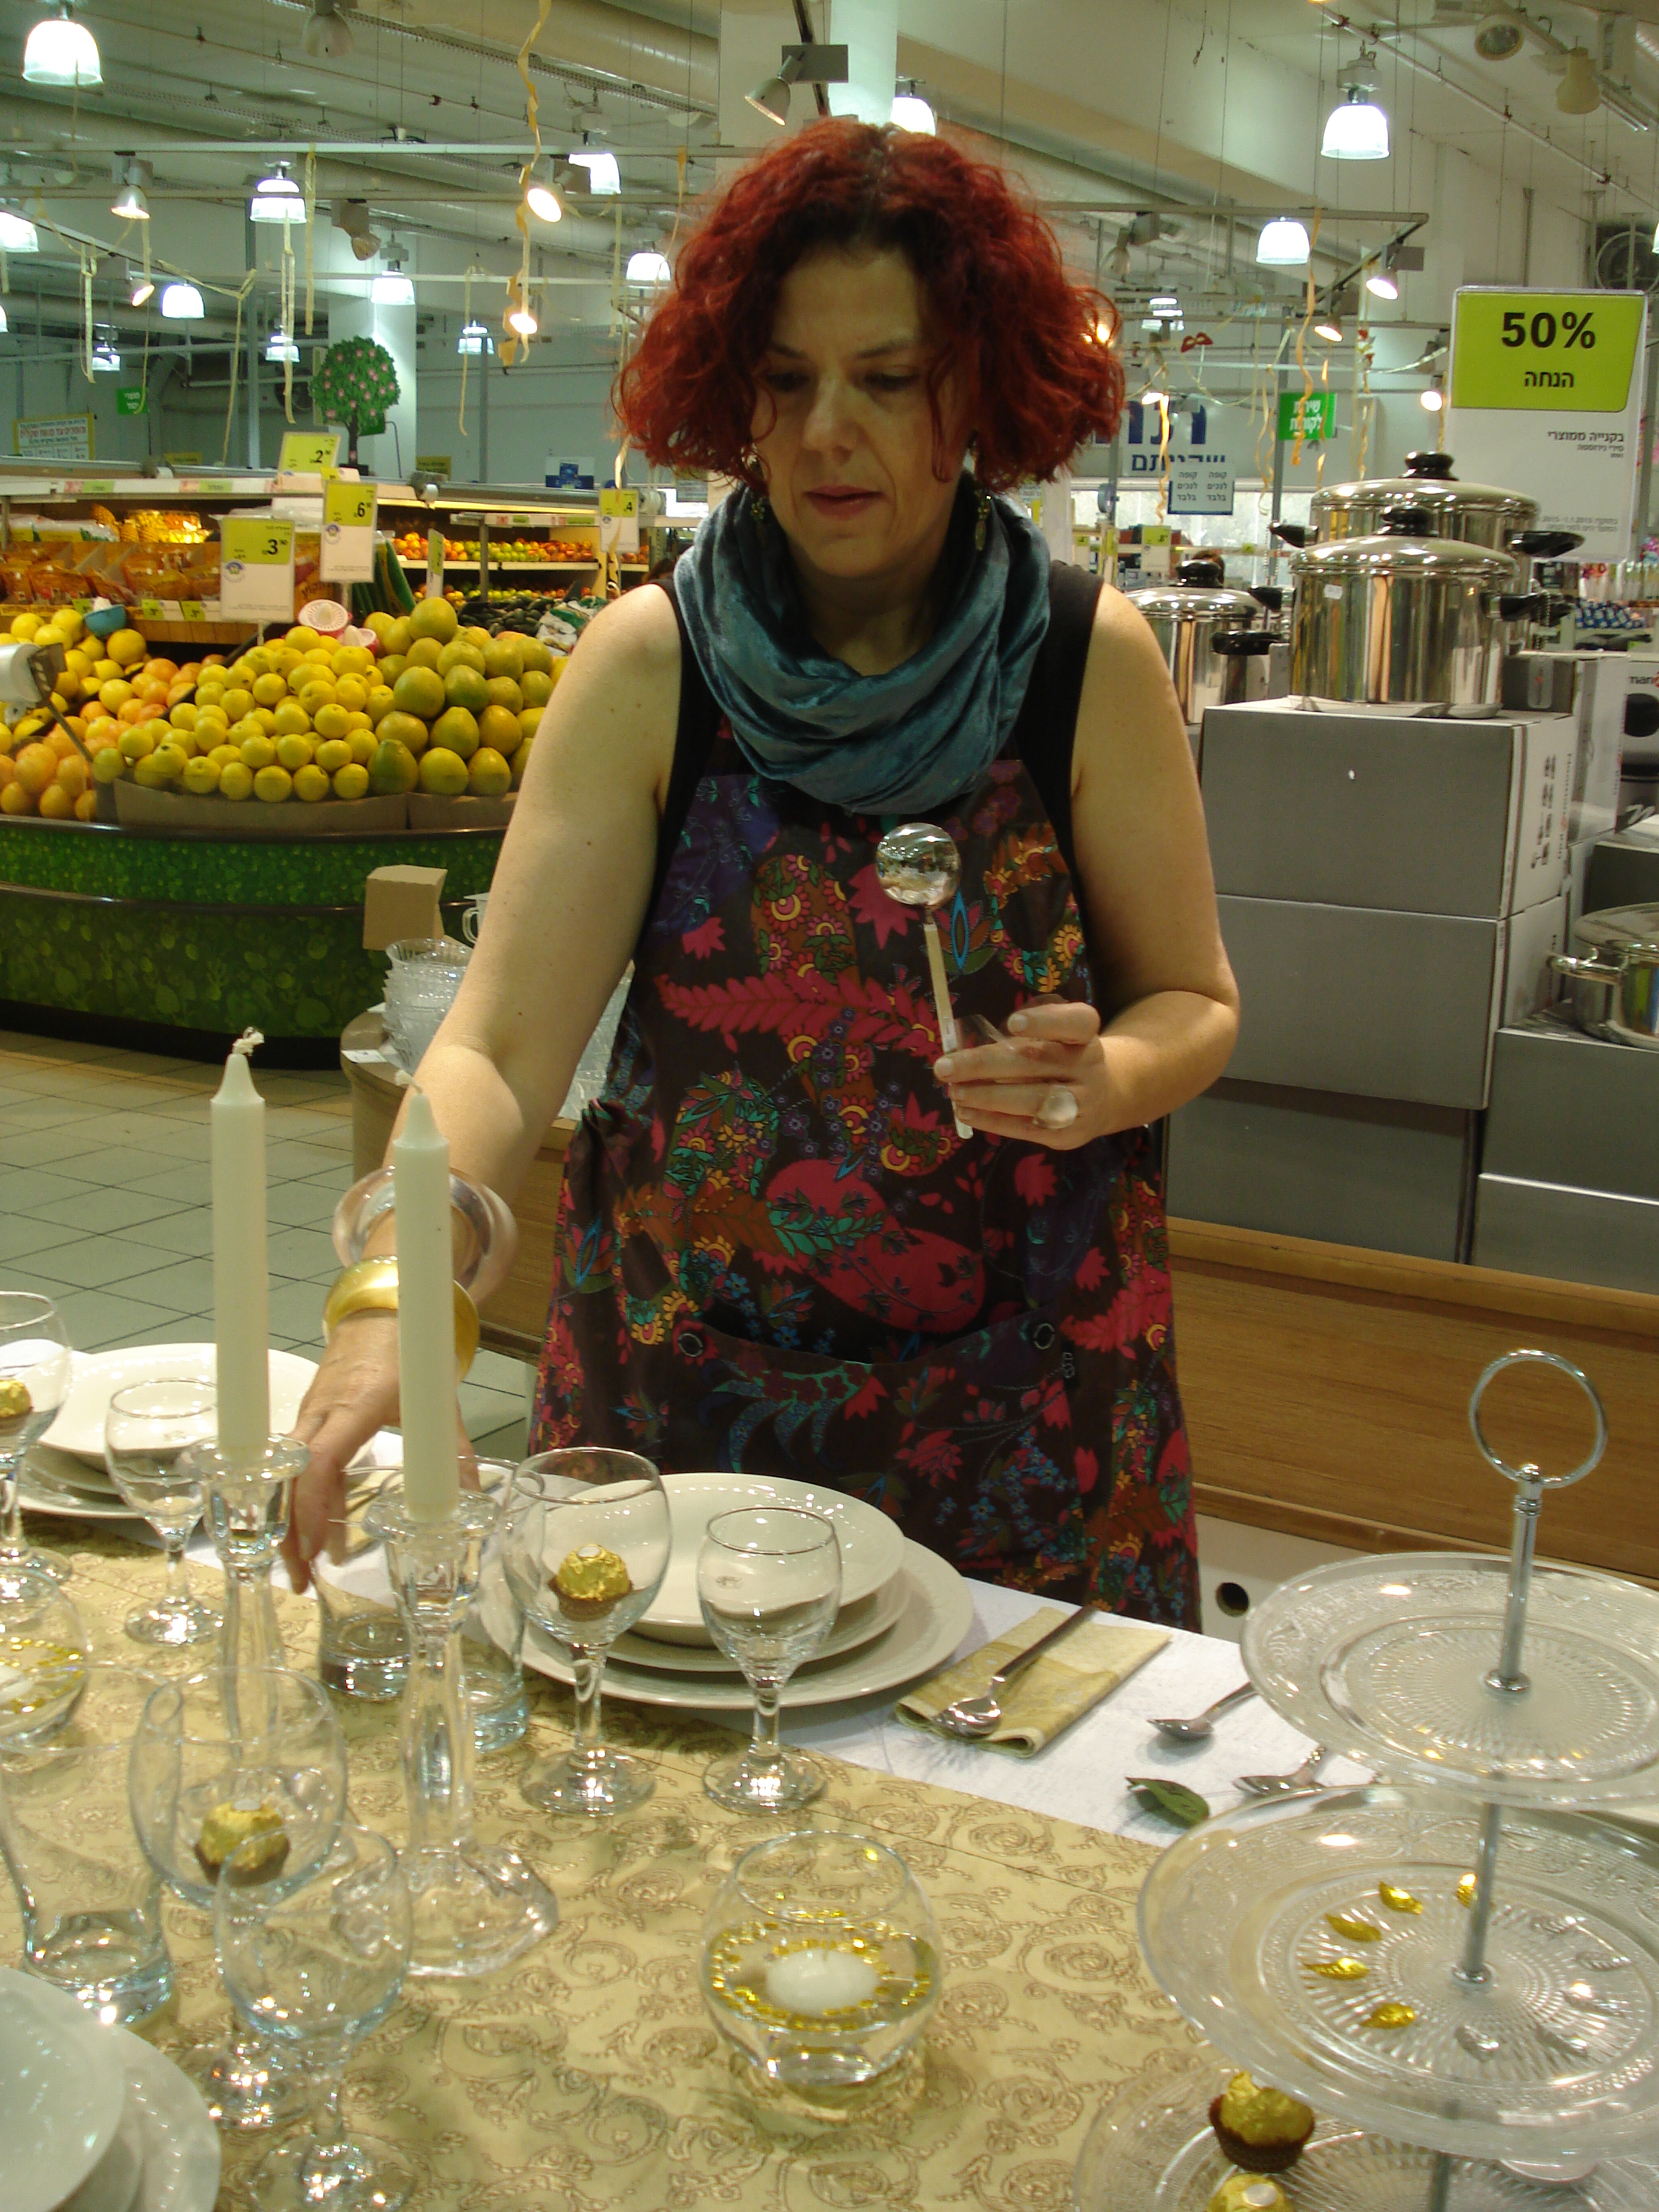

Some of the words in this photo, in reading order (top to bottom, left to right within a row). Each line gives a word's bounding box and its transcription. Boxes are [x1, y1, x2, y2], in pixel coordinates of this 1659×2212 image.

[1501, 312, 1596, 349] 50%
[1524, 372, 1574, 387] הנחה
[1293, 400, 1321, 413] שירת
[1290, 413, 1322, 433] לקוחת
[1547, 431, 1586, 441] ממוצרי
[1588, 433, 1624, 444] בקנייה
[315, 449, 323, 463] 2
[358, 503, 366, 517] 6
[267, 539, 278, 554] 3
